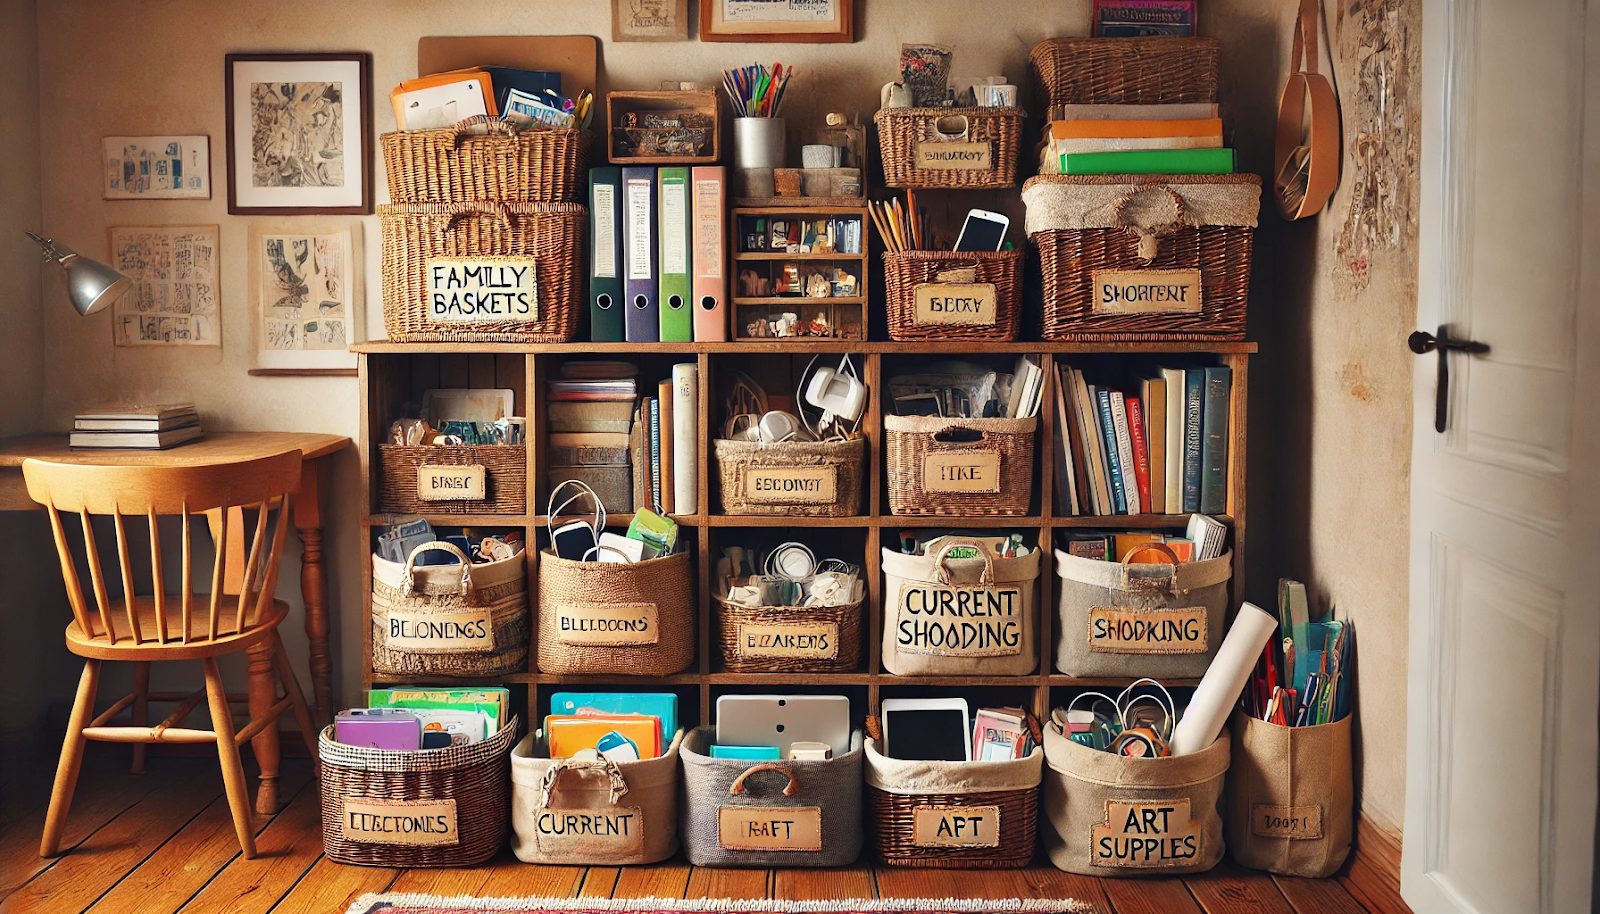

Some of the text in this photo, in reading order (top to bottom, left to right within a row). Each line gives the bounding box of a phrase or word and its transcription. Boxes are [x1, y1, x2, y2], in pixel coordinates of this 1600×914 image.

[433, 293, 530, 314] BASKETS
[905, 588, 1018, 617] CURRENT
[538, 813, 635, 837] CURRENT
[1123, 807, 1175, 834] ART
[1098, 835, 1197, 861] SUPPLES
